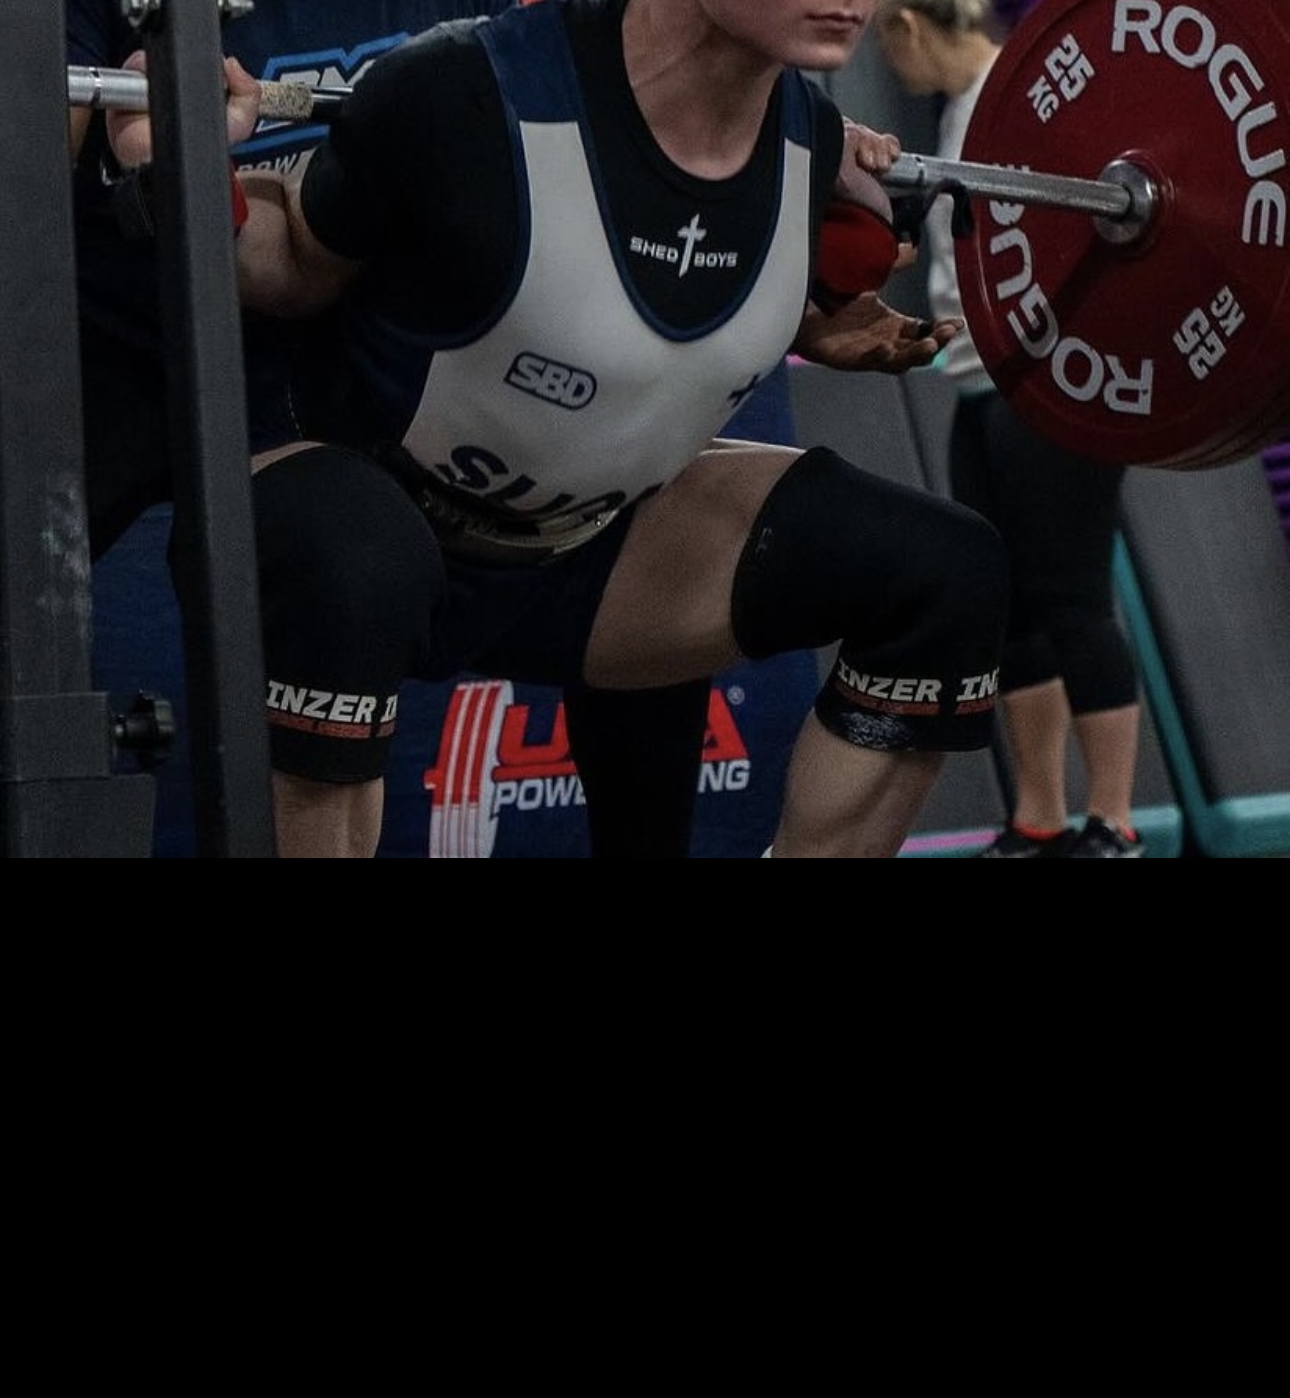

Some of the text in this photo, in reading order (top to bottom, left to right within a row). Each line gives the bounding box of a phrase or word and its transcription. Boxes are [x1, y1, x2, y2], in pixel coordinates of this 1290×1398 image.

[1026, 33, 1096, 124] 25 KG
[630, 235, 738, 269] SHED BOYS
[1172, 285, 1246, 380] 25 KG
[507, 354, 596, 407] SBD
[266, 680, 378, 723] INZER
[838, 657, 943, 703] INZER
